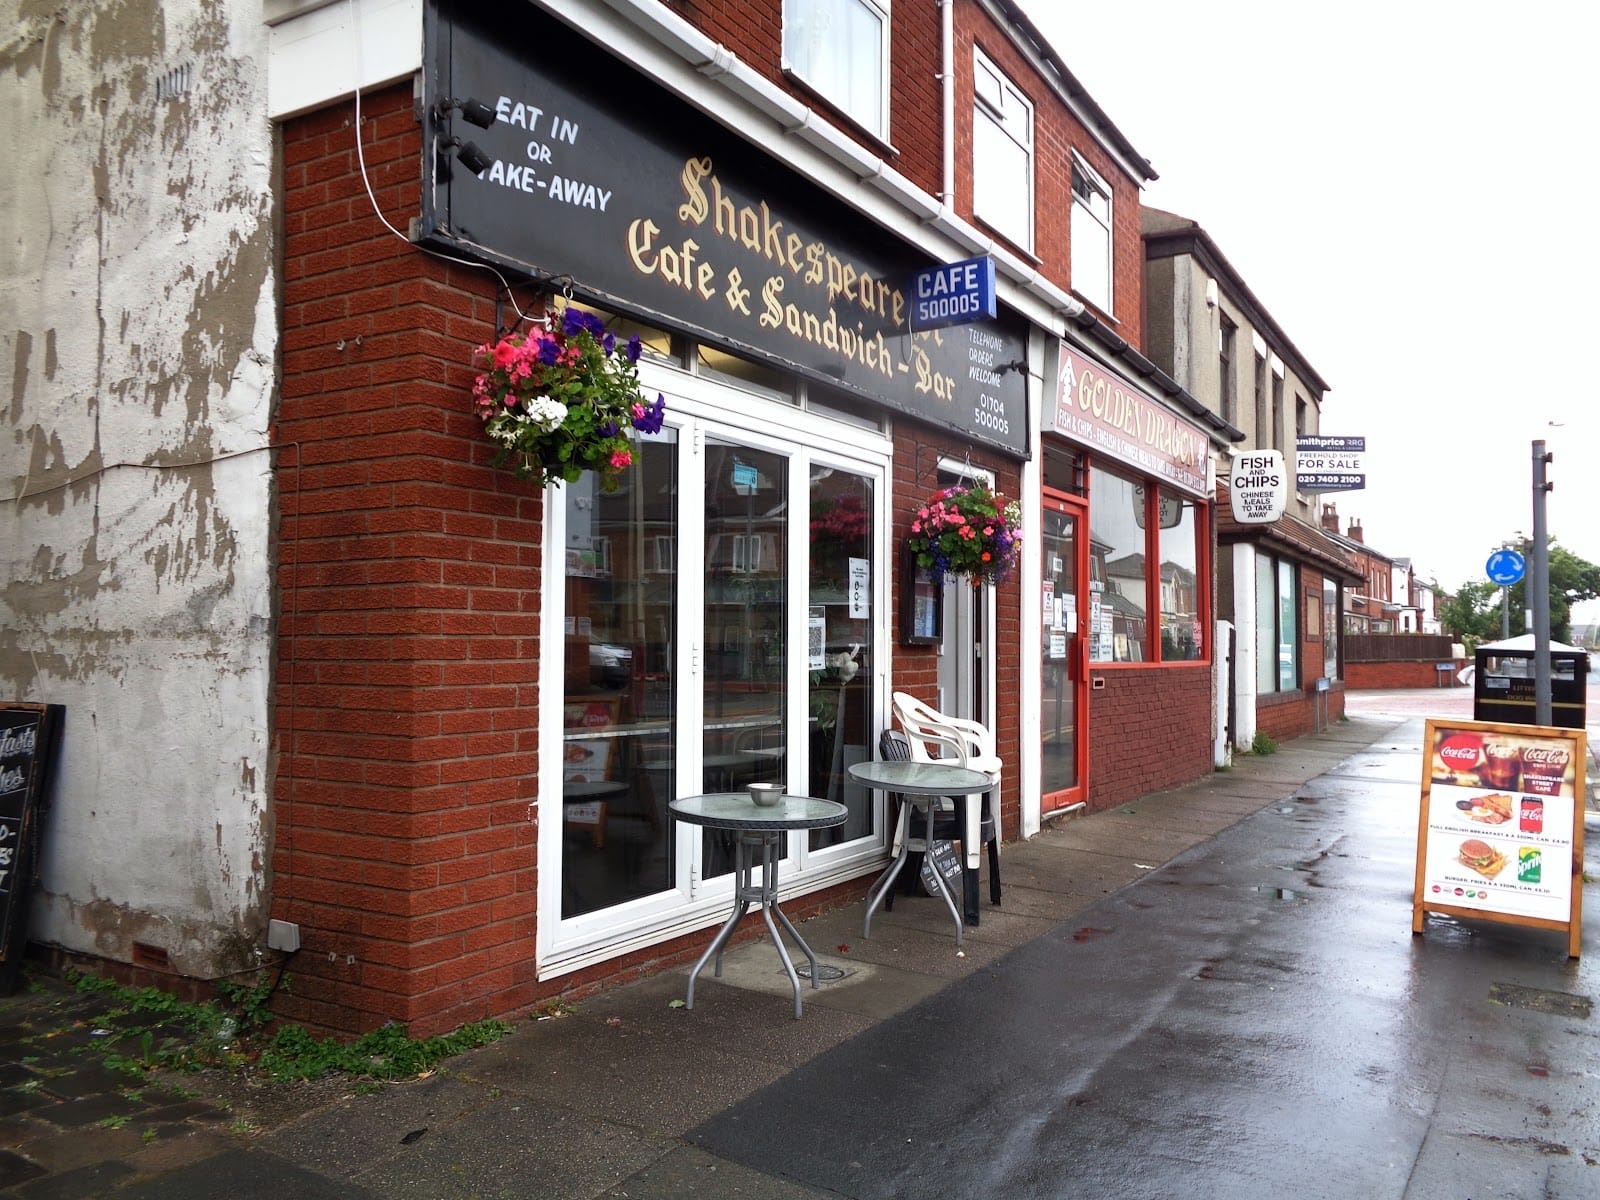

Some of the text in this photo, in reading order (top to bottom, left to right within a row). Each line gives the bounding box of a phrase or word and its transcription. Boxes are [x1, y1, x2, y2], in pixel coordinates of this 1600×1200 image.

[495, 95, 579, 145] EAT IN
[526, 141, 553, 165] OR
[477, 159, 612, 212] AKE-AWAY
[678, 156, 906, 327] Shakespeare
[627, 218, 716, 300] Cafe
[724, 266, 752, 317] &
[917, 264, 979, 299] CAFE
[919, 292, 980, 321] 500005
[968, 328, 1003, 353] TELEPHONE
[968, 349, 994, 367] ORDERS
[968, 366, 1002, 388] WELCOME
[980, 393, 1005, 415] 01704
[974, 408, 1010, 435] 500005
[1077, 416, 1093, 440] CHIPS
[1078, 369, 1144, 440] GOLDEN
[1145, 408, 1196, 468] DRAGON
[1241, 457, 1274, 469] FISH
[1298, 459, 1360, 468] FOR SALE
[1234, 475, 1279, 488] CHIPS
[1298, 475, 1361, 483] 020 7409 2100
